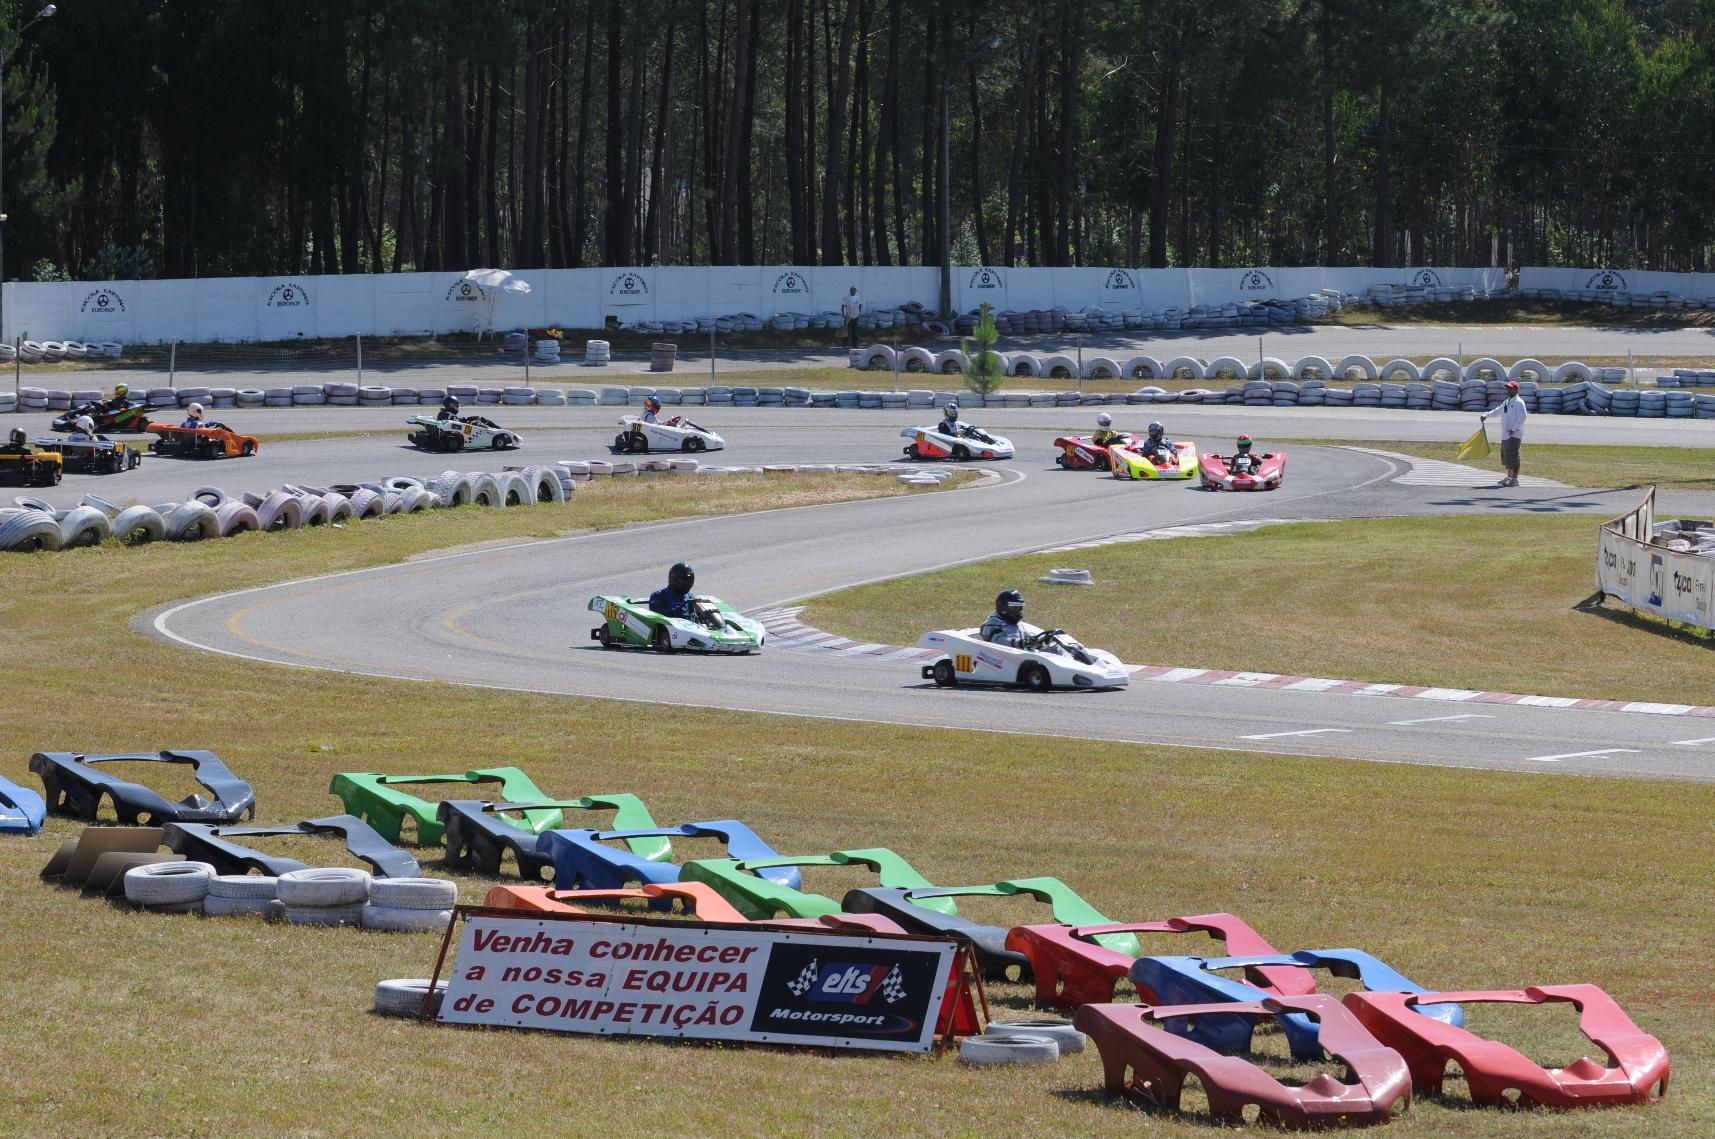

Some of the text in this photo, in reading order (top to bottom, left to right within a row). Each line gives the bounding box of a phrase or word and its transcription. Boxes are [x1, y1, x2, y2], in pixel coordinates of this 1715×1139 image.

[81, 289, 100, 312] ESCOLA
[473, 929, 758, 964] Venha conhecer
[465, 965, 748, 993] a nossa EQUIPA
[453, 994, 744, 1030] de COMPETIÇÃO
[769, 1008, 885, 1025] Motorsport
